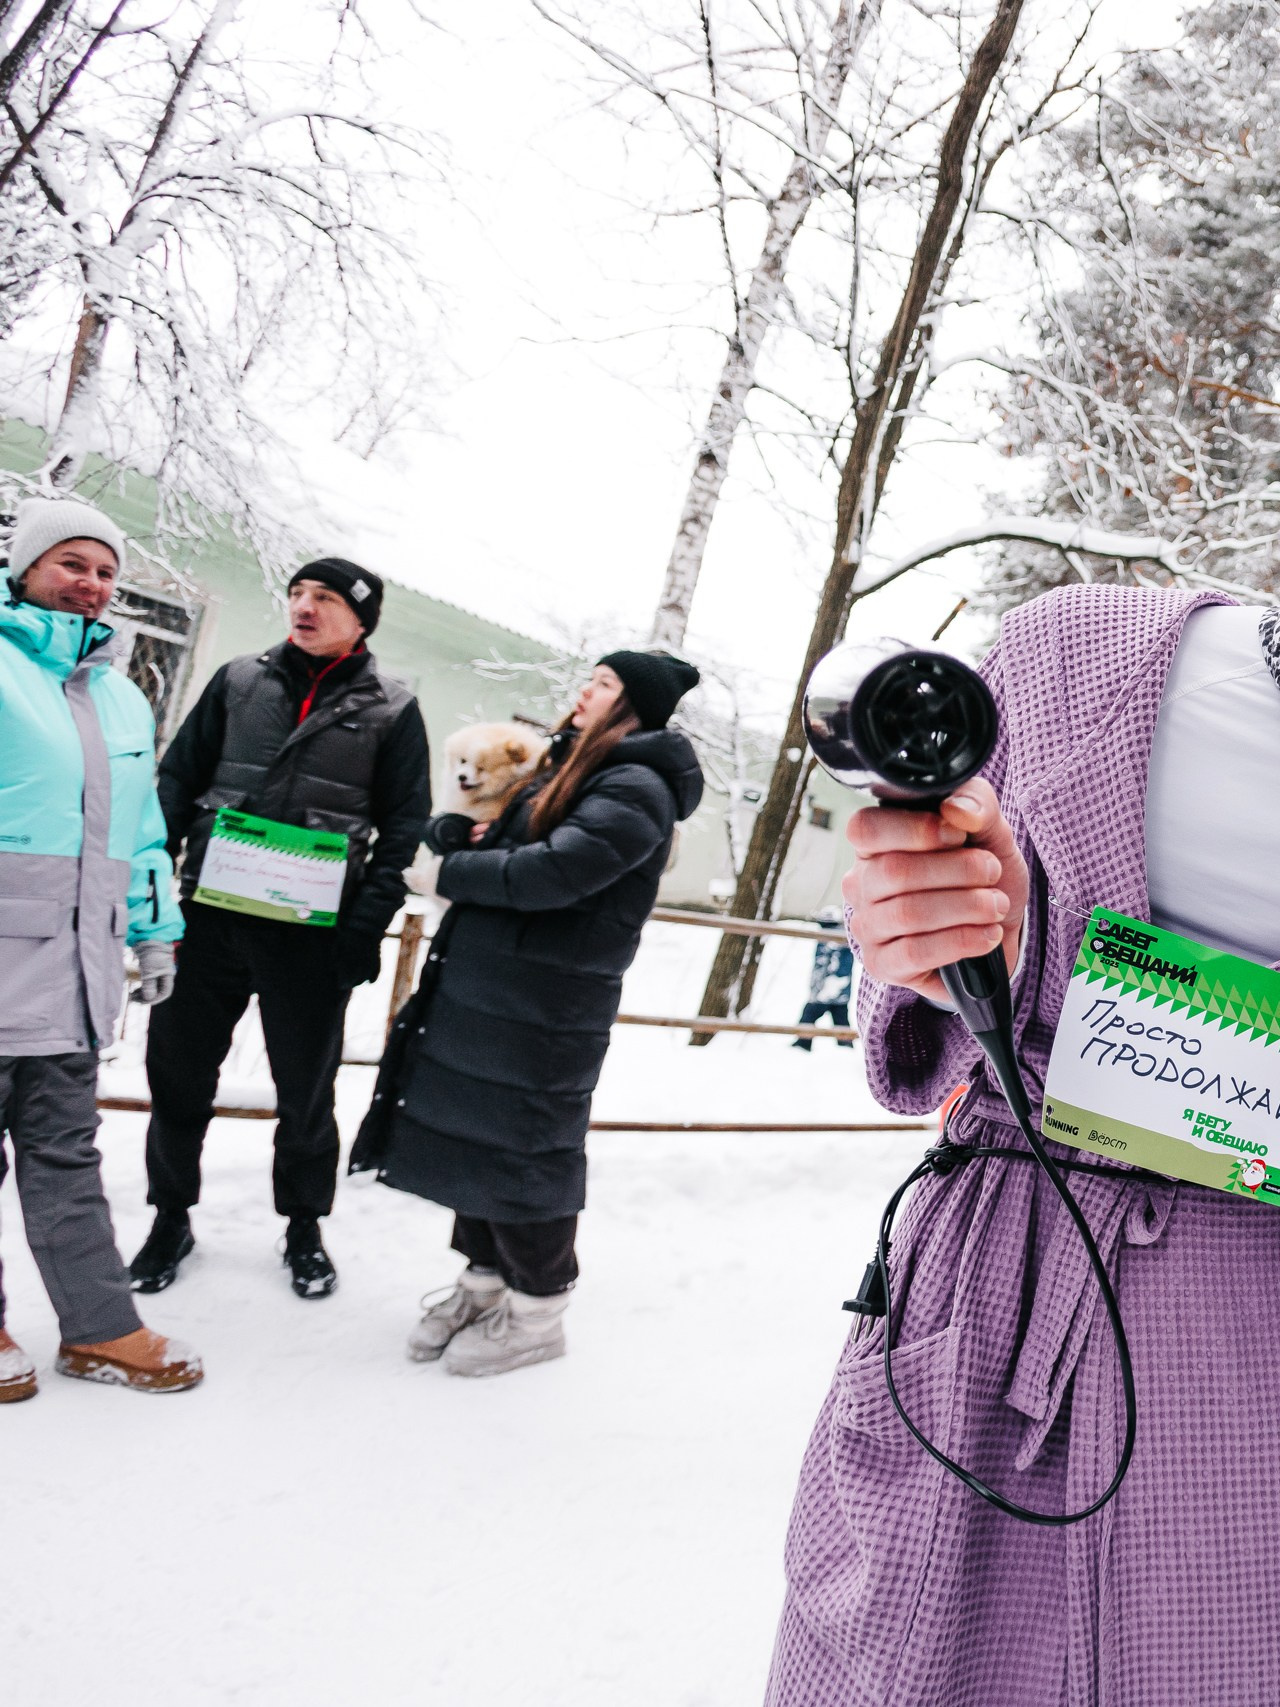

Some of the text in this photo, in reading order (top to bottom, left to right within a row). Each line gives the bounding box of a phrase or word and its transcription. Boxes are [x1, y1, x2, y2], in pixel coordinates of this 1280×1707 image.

[1090, 937, 1198, 987] ОБЕЩАНИЙ
[1100, 957, 1119, 968] 2025
[1182, 1108, 1232, 1131] Я БЕГУ
[1191, 1125, 1268, 1156] И ОБЕЩАЮ
